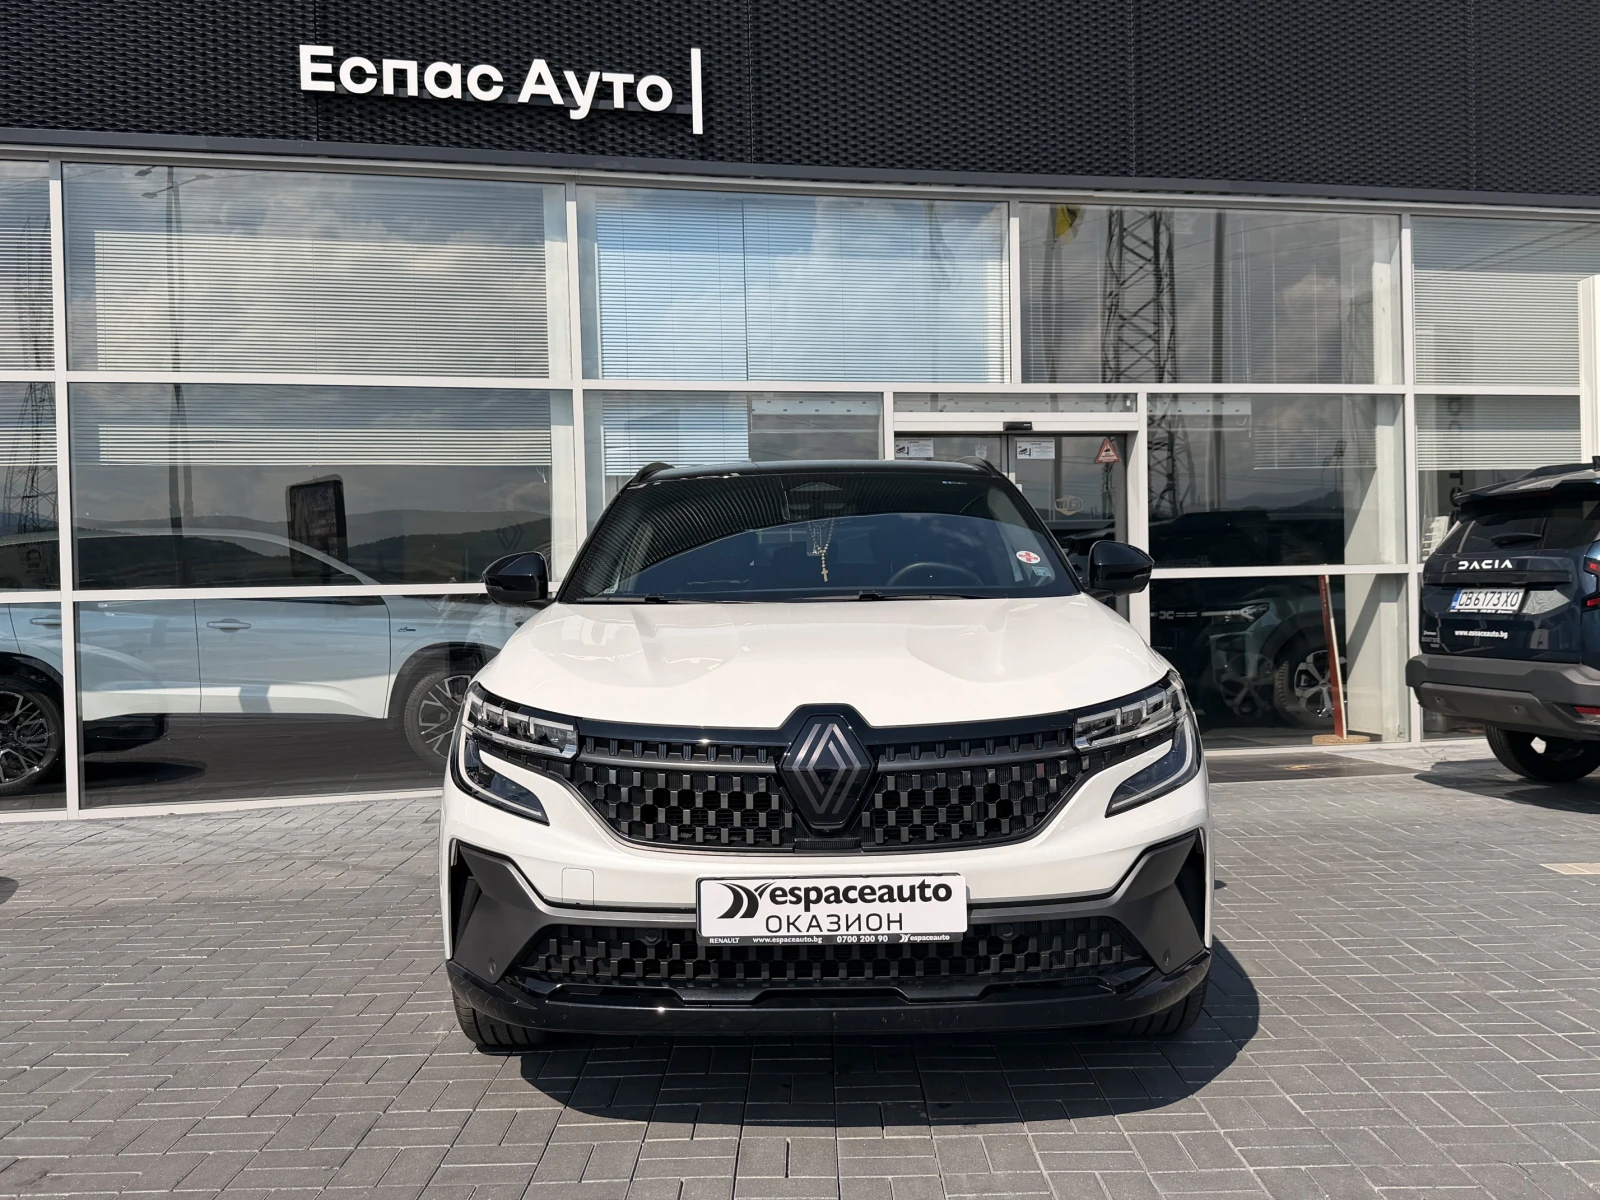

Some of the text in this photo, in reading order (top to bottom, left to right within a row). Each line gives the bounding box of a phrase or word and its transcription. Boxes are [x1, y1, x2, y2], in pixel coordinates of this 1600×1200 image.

[299, 44, 674, 120] Еспас Ауто
[1457, 559, 1513, 570] DACIA
[769, 879, 953, 912] espaceauto
[765, 912, 903, 933] ОКАЗИОН
[752, 936, 823, 944] www.espaceauto.bg
[836, 935, 858, 943] 0700
[859, 935, 875, 943] 200
[877, 935, 889, 943] 90
[910, 933, 950, 942] espaceauto
